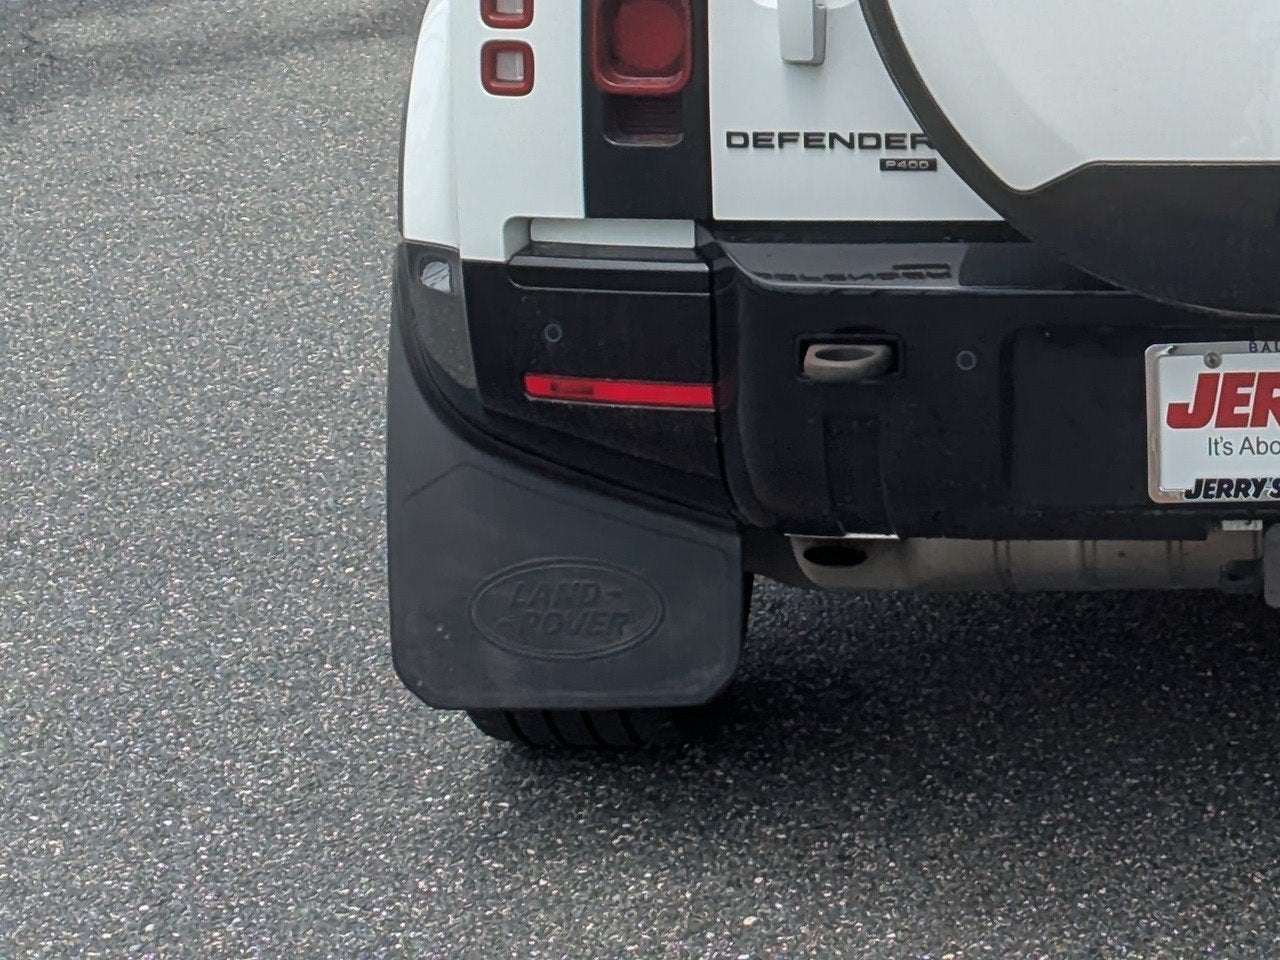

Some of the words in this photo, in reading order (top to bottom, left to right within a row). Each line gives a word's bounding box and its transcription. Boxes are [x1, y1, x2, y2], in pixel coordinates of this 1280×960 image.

[726, 130, 938, 150] DEFENDER
[885, 160, 930, 170] P400
[1208, 436, 1234, 456] It's
[510, 580, 601, 609] LAND
[517, 609, 631, 641] ROVER
